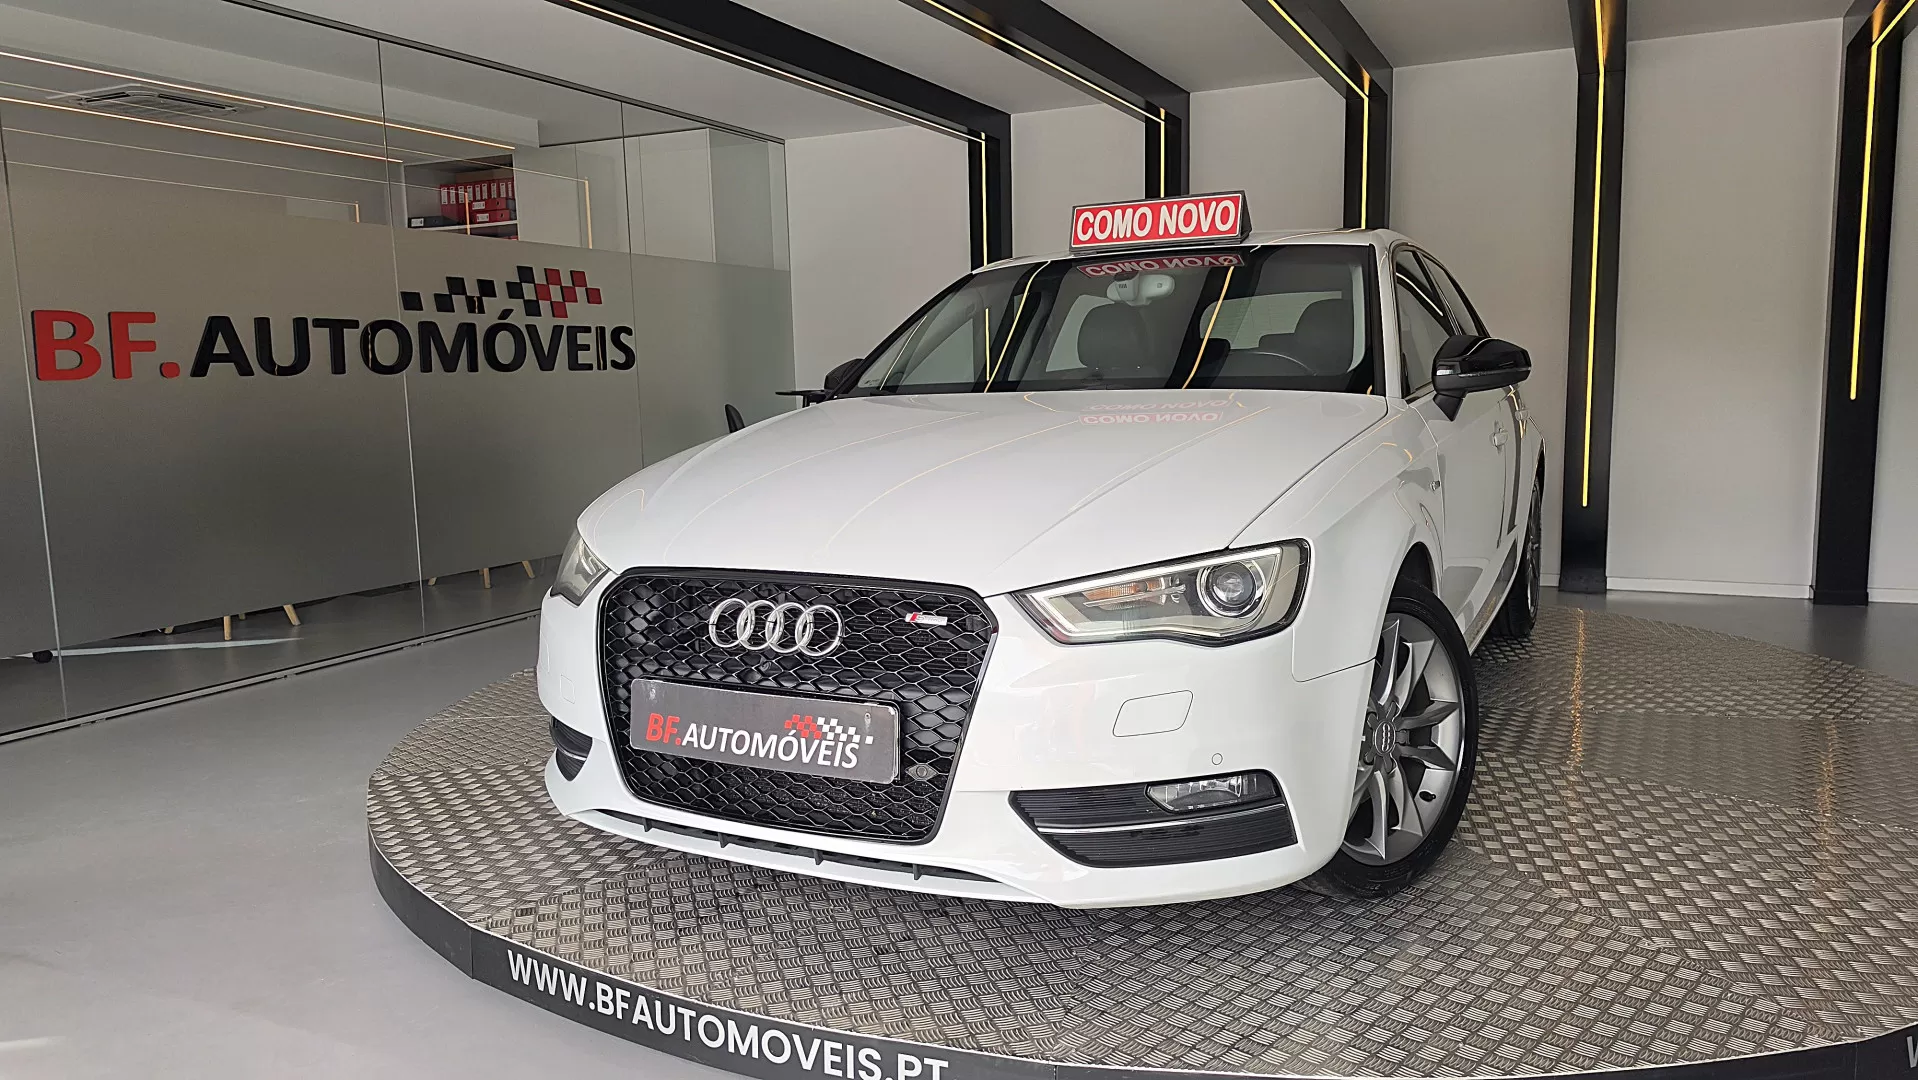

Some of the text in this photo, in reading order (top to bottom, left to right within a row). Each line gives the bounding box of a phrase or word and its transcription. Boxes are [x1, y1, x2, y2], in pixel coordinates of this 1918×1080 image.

[1077, 199, 1236, 241] COMO NOVO
[31, 309, 636, 381] BF.AUTOMÓVEIS
[646, 713, 860, 769] BF.AUTOMÓVEIS
